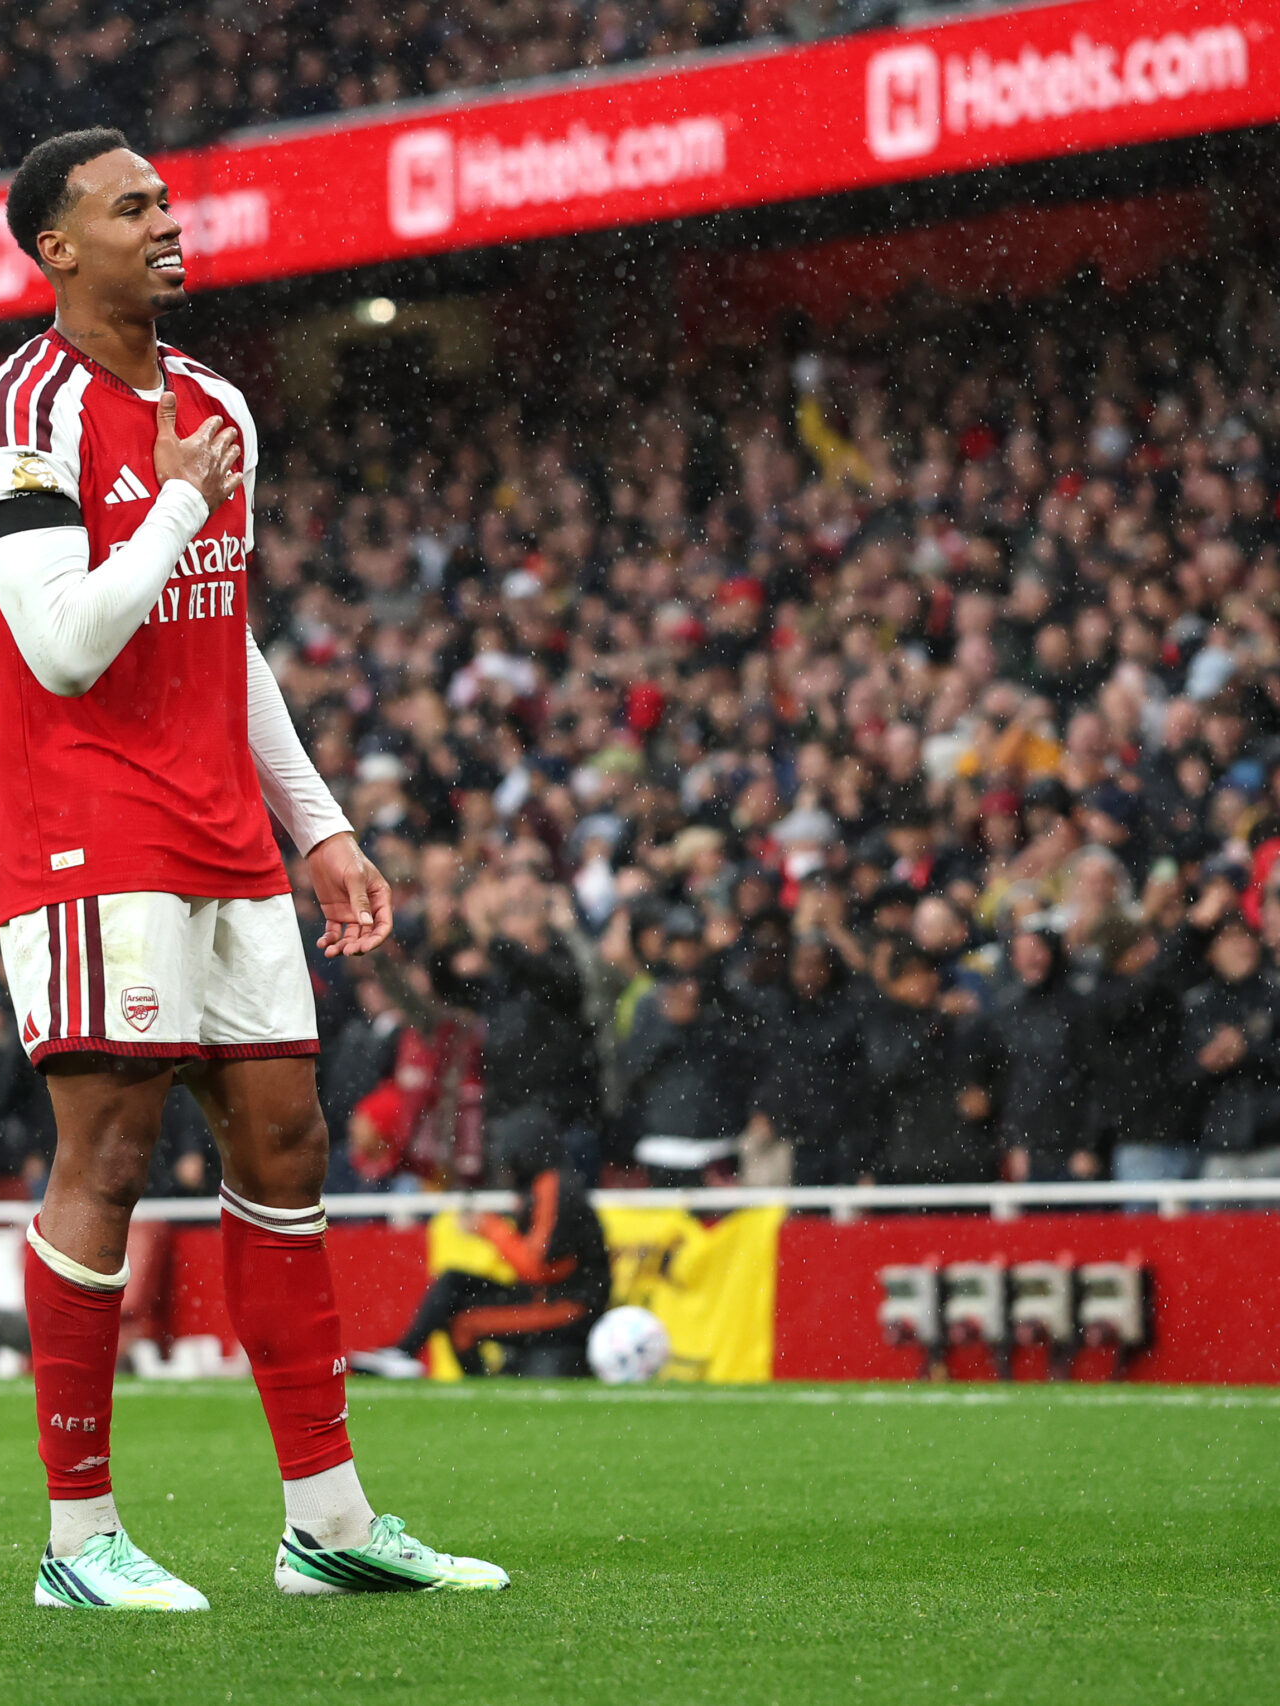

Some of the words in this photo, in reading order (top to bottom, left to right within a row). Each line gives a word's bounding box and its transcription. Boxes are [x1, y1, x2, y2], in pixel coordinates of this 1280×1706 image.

[943, 24, 1249, 134] Hotels.com
[458, 118, 725, 214] Hotels.com
[144, 586, 180, 625] LY
[127, 994, 155, 1002] Arsenal
